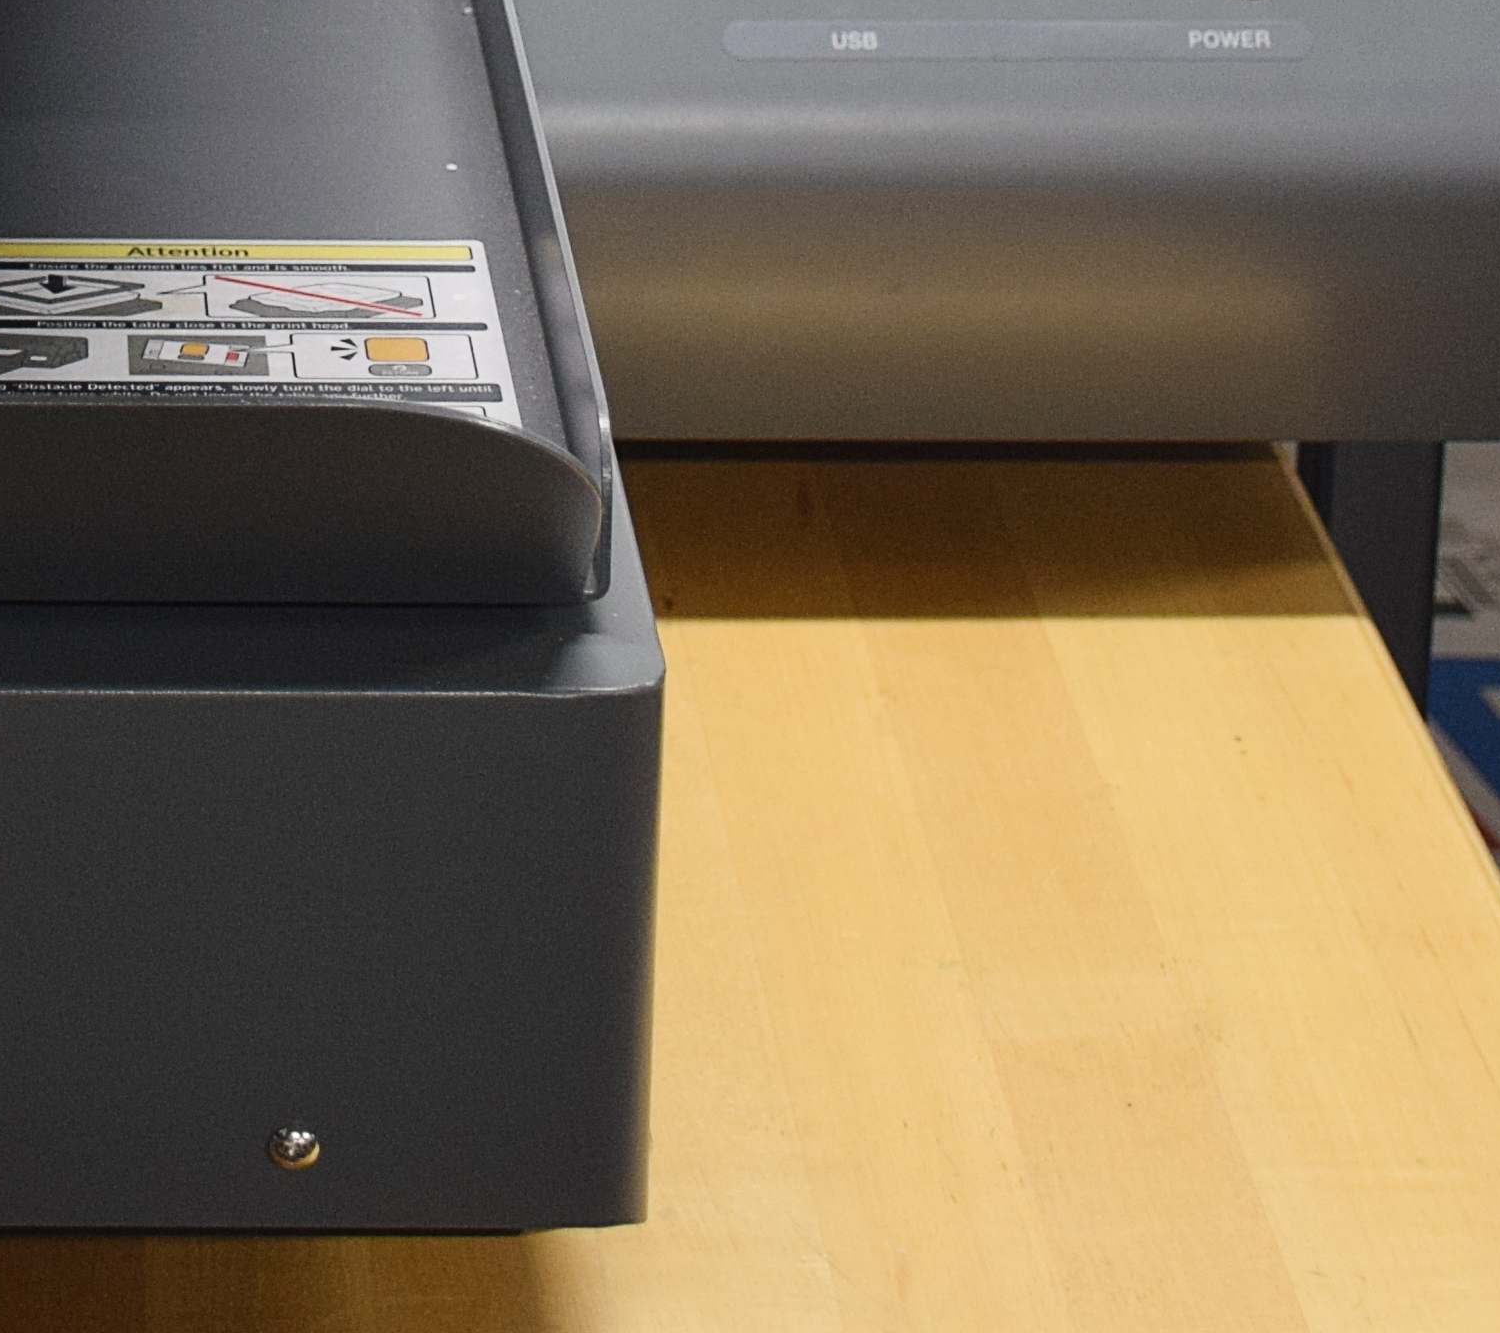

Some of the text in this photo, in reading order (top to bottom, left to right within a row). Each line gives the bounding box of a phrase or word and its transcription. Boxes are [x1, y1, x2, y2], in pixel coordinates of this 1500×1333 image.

[831, 30, 878, 51] USB
[1188, 28, 1272, 50] POWER
[127, 246, 249, 257] Attention
[113, 263, 175, 272] garment
[37, 321, 96, 329] Position
[102, 321, 126, 329] the
[132, 321, 170, 329] table
[175, 321, 215, 329] close
[270, 322, 307, 331] print
[165, 384, 227, 393] appears,
[231, 383, 278, 393] slowly
[283, 384, 314, 392] turn
[318, 384, 342, 392] the
[347, 384, 373, 392] dial
[378, 384, 394, 392] to
[398, 384, 423, 393] the
[427, 385, 454, 393] left
[458, 385, 493, 393] until
